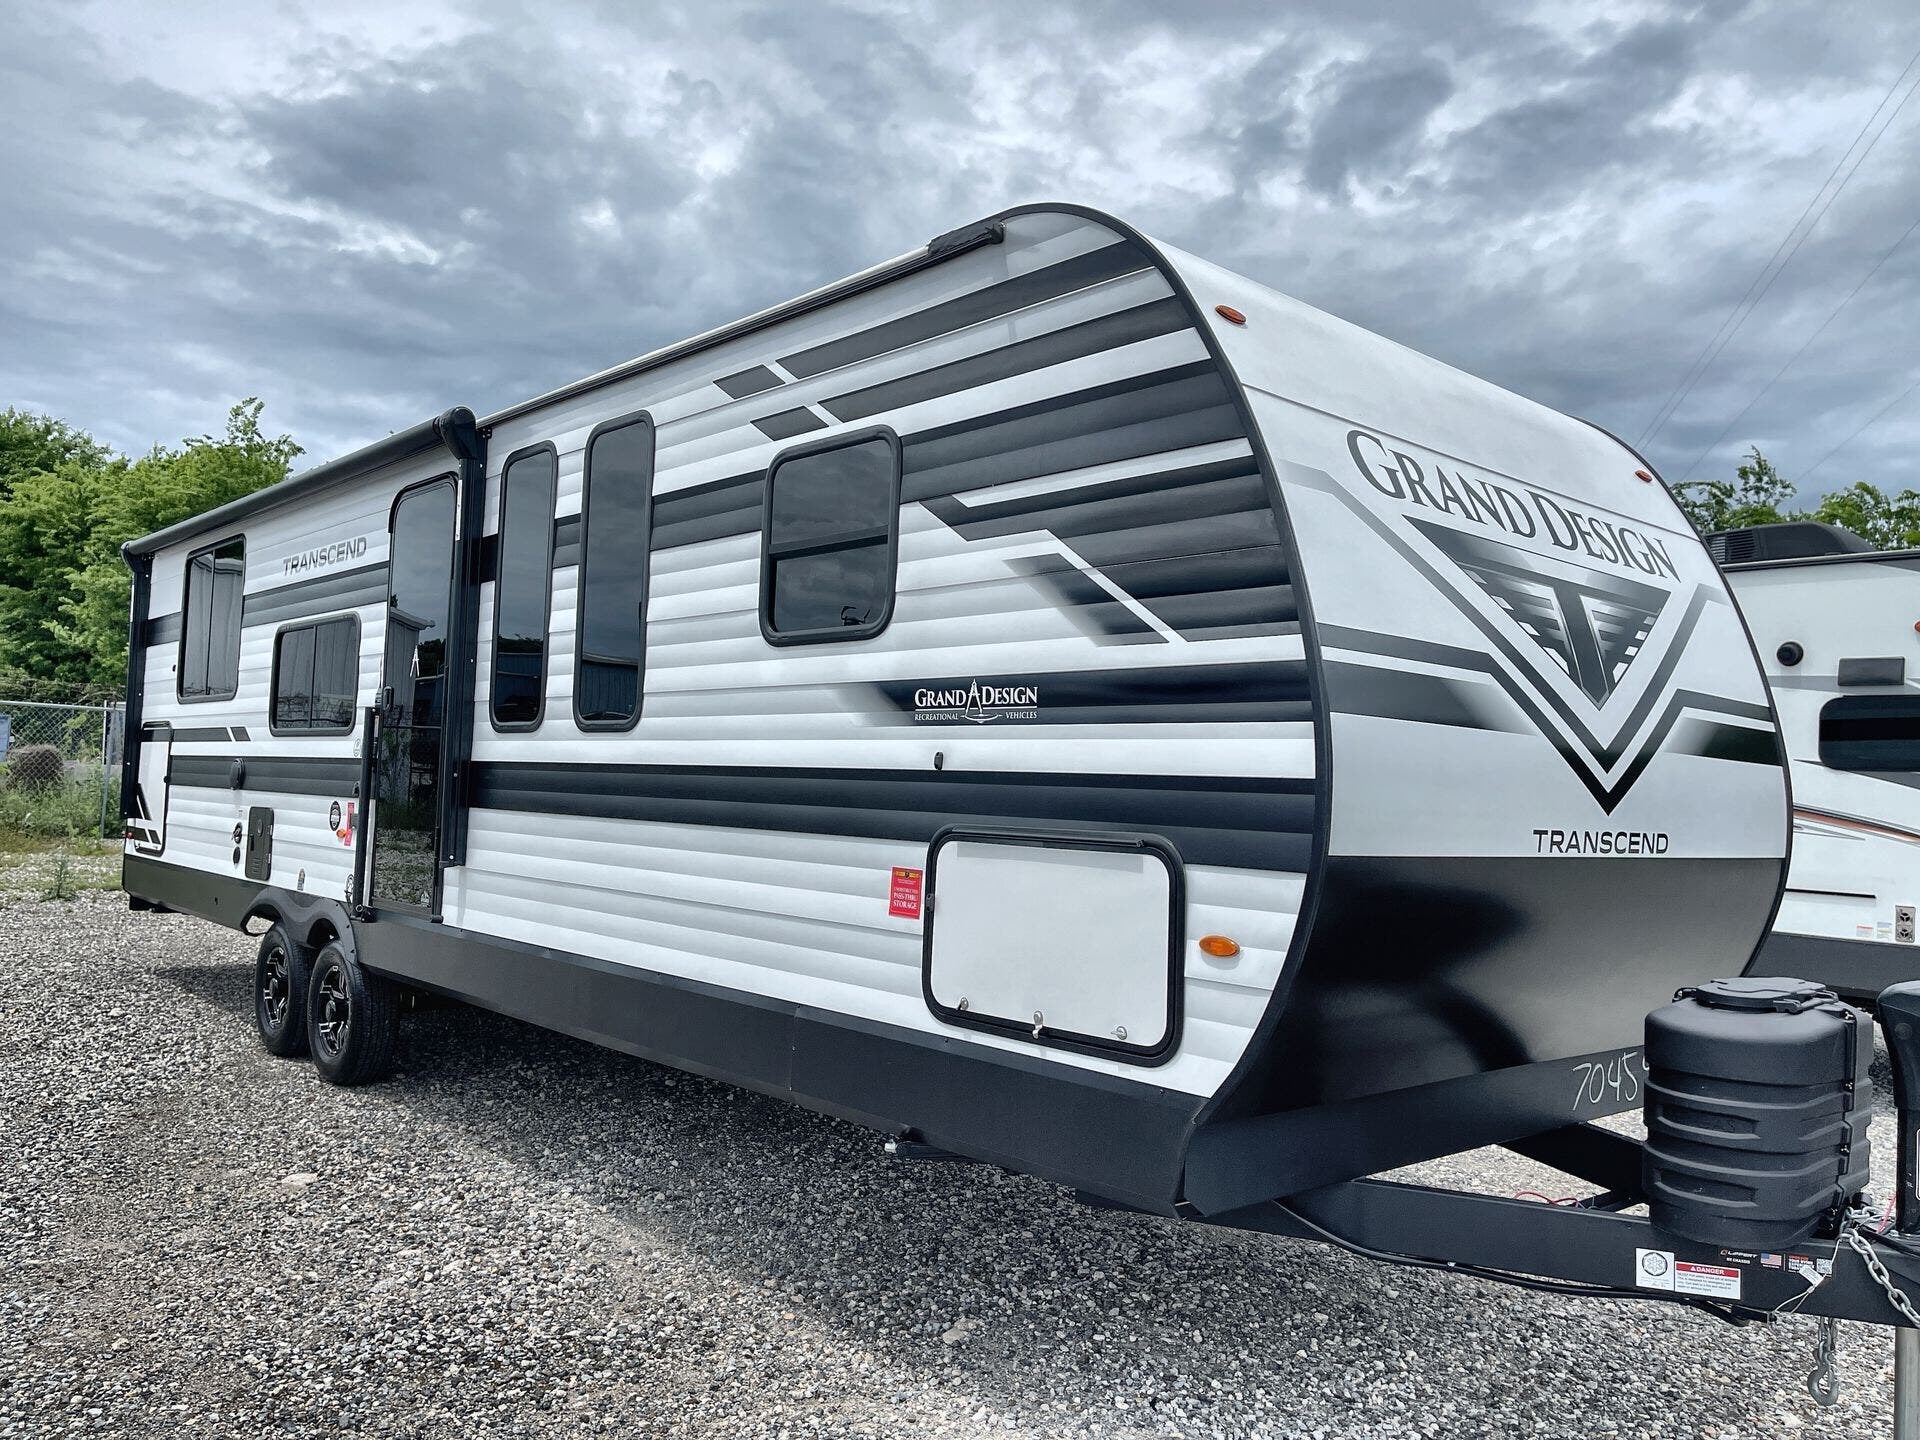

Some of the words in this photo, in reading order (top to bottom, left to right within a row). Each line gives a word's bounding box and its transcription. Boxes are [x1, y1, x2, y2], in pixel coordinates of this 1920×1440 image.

[1346, 429, 1536, 539] GRAND
[1524, 489, 1681, 584] DESIGN
[283, 536, 367, 576] TRANSCEND
[914, 688, 966, 706] GRAND
[981, 686, 1038, 704] DESIGN
[914, 713, 959, 721] RECREATIONAL
[1005, 711, 1038, 719] VEHICLES
[1533, 829, 1669, 855] TRANSCEND
[893, 900, 917, 909] STORAGE
[1696, 1266, 1725, 1275] DANGER
